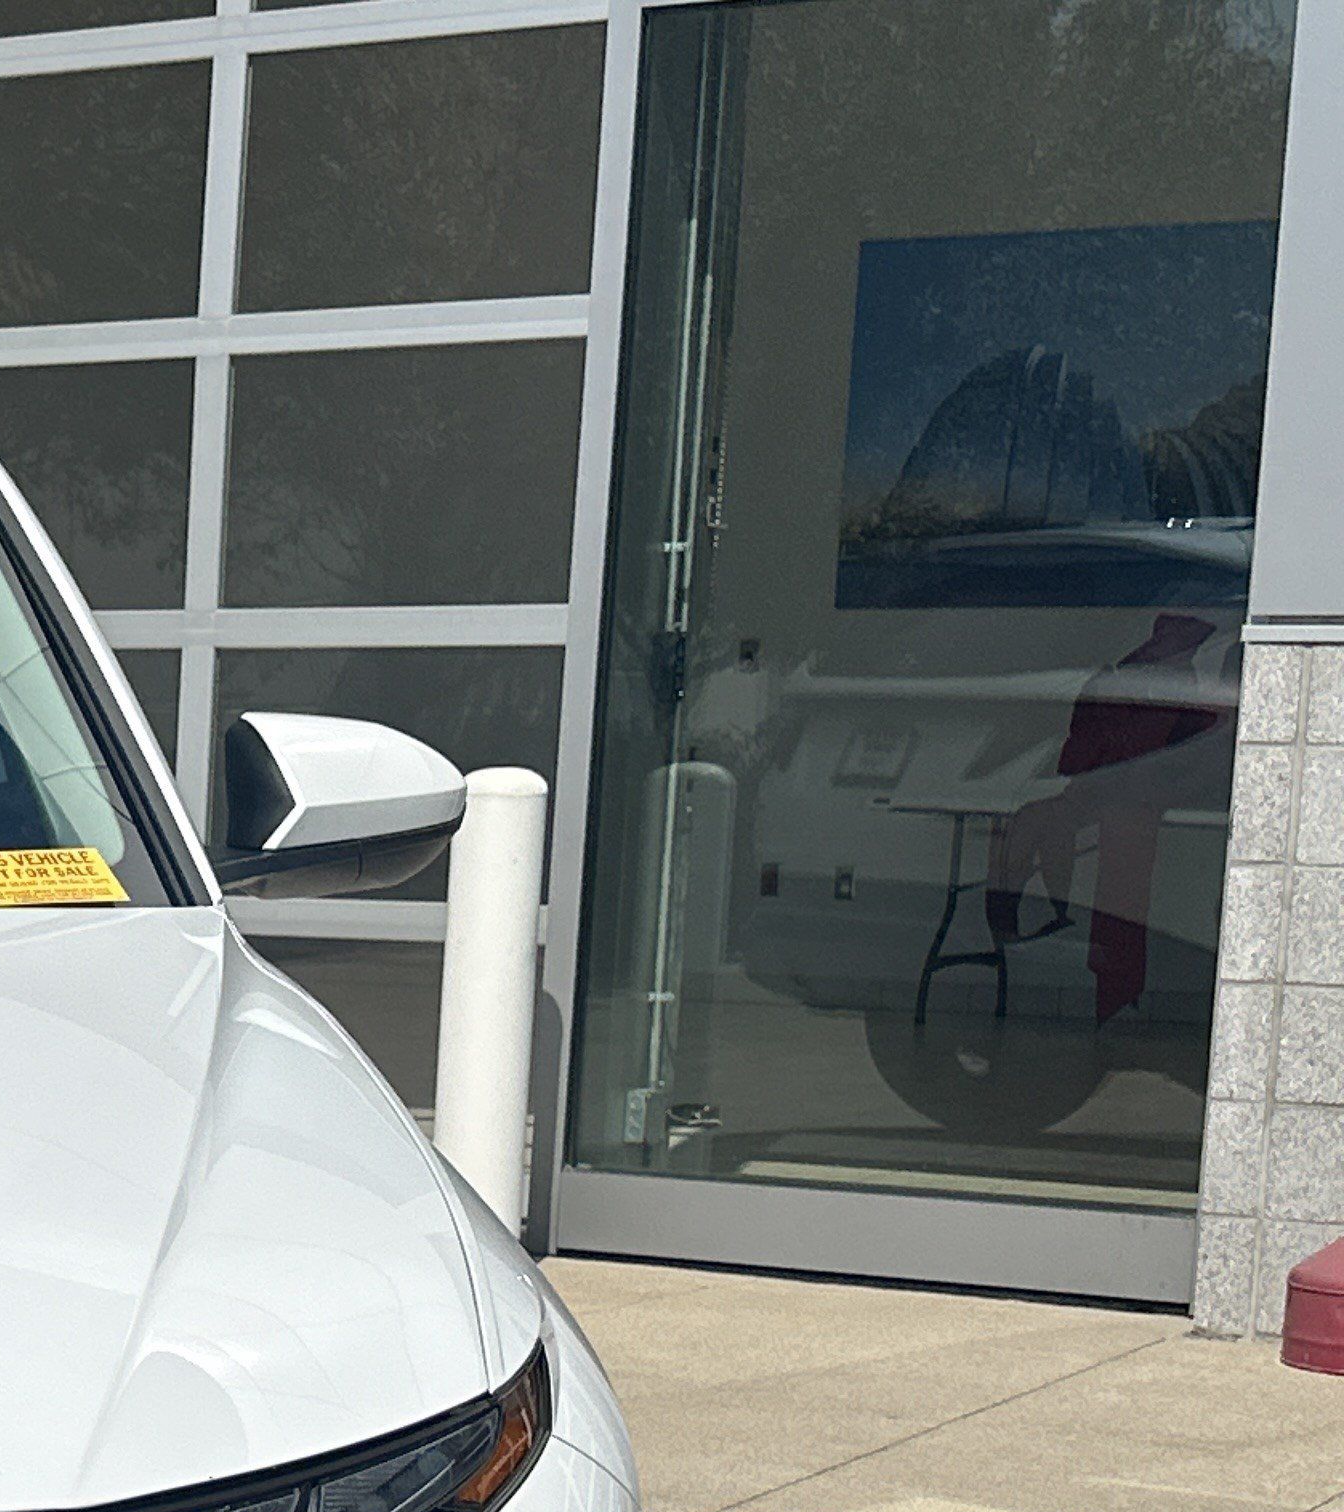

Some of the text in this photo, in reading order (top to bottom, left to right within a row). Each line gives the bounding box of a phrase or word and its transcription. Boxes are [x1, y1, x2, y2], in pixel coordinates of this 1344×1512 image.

[10, 850, 95, 866] VEHICLE
[14, 867, 50, 879] FOR
[53, 865, 100, 877] SALE
